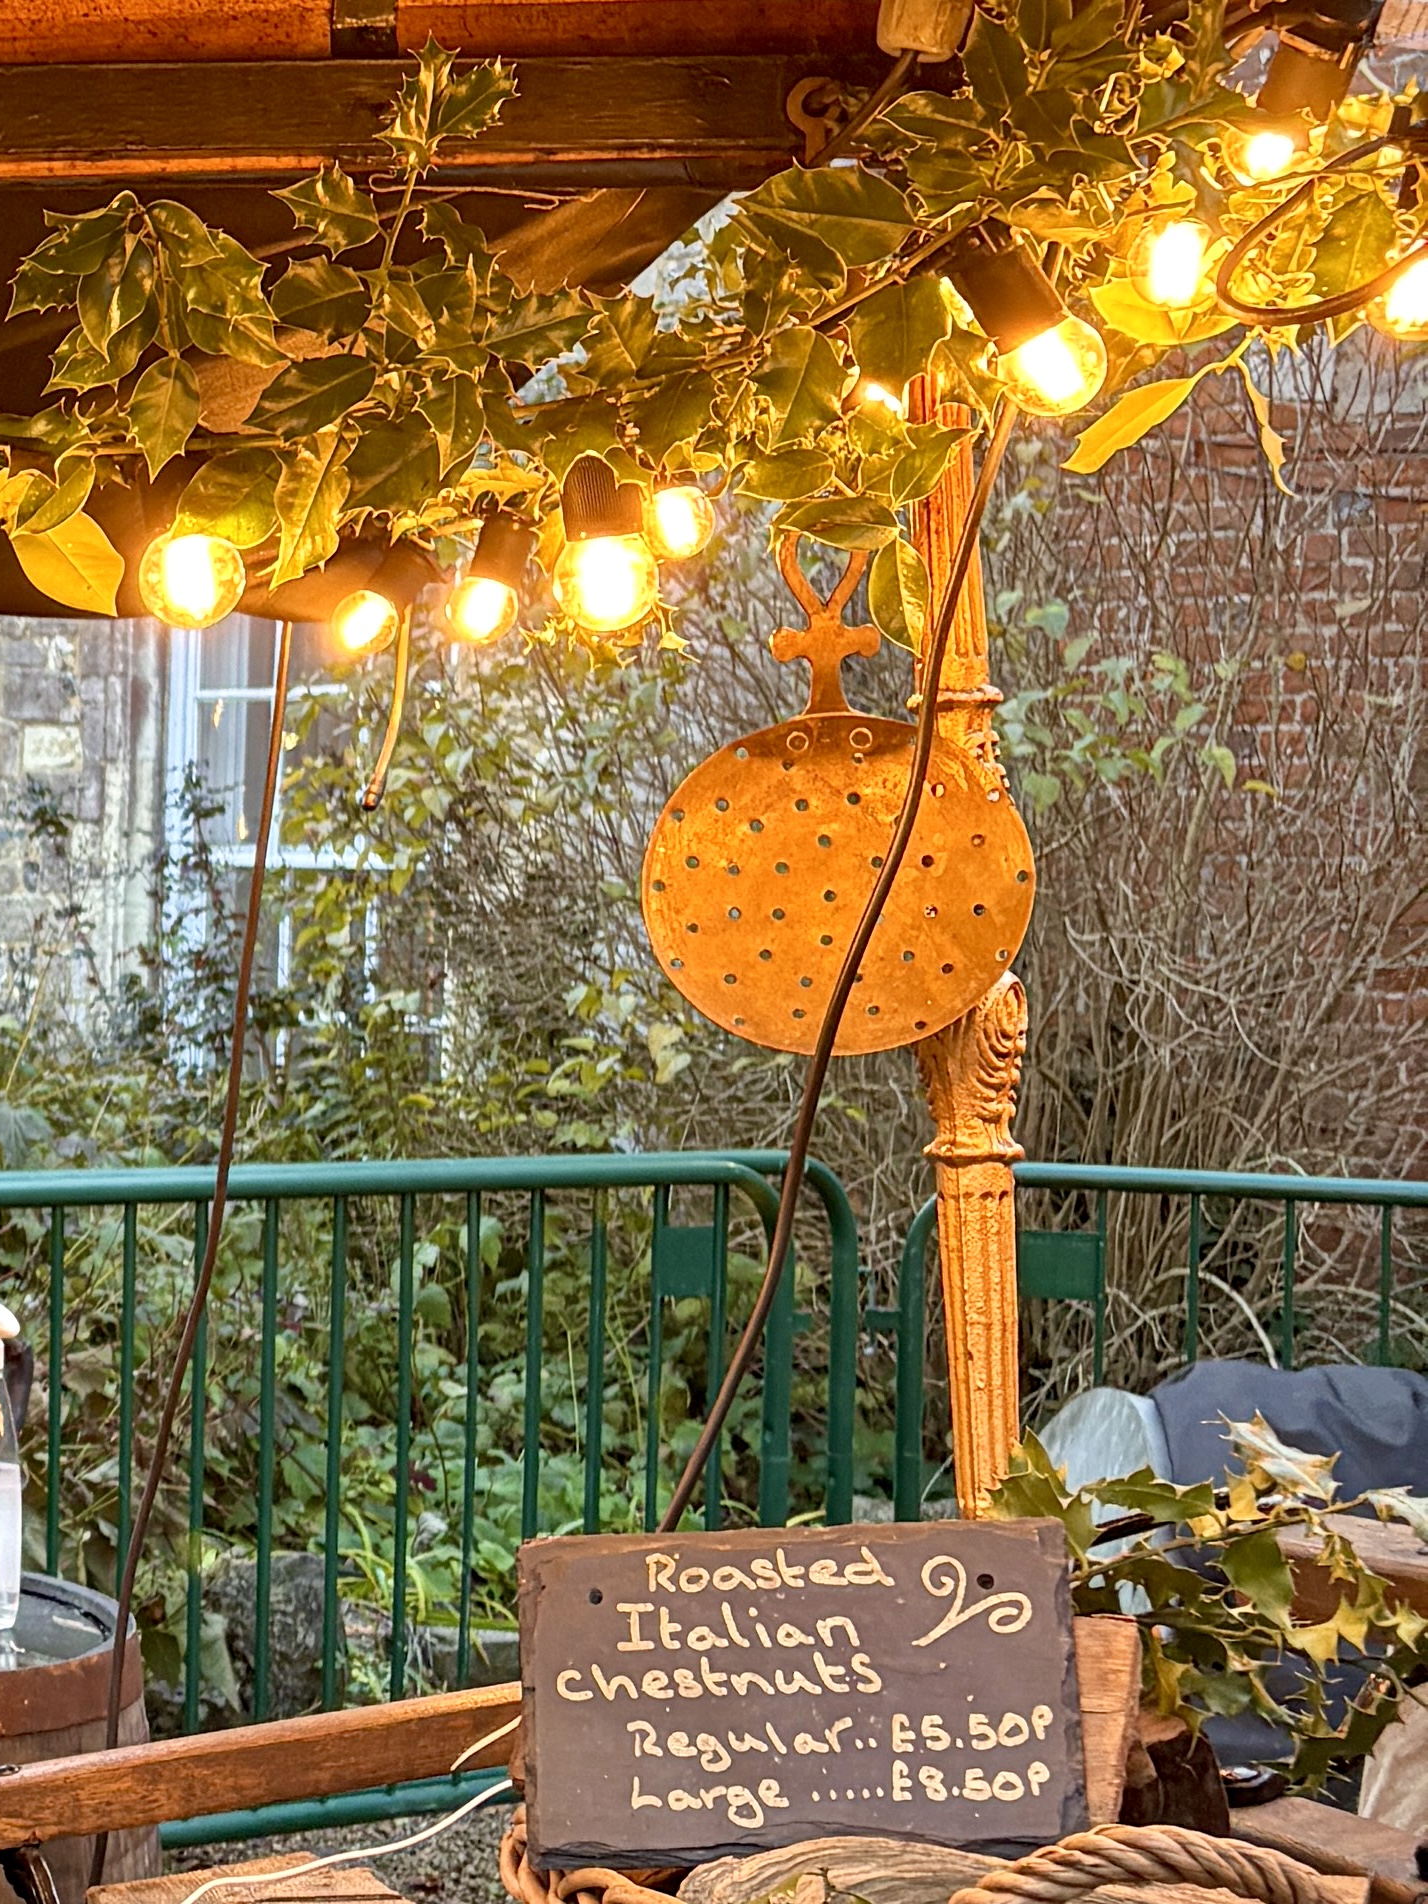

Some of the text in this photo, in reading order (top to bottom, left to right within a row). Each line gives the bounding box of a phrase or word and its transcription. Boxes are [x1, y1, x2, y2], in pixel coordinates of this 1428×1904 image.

[645, 1544, 895, 1594] Roasted
[616, 1600, 861, 1652] Italian
[631, 1776, 790, 1828] Large
